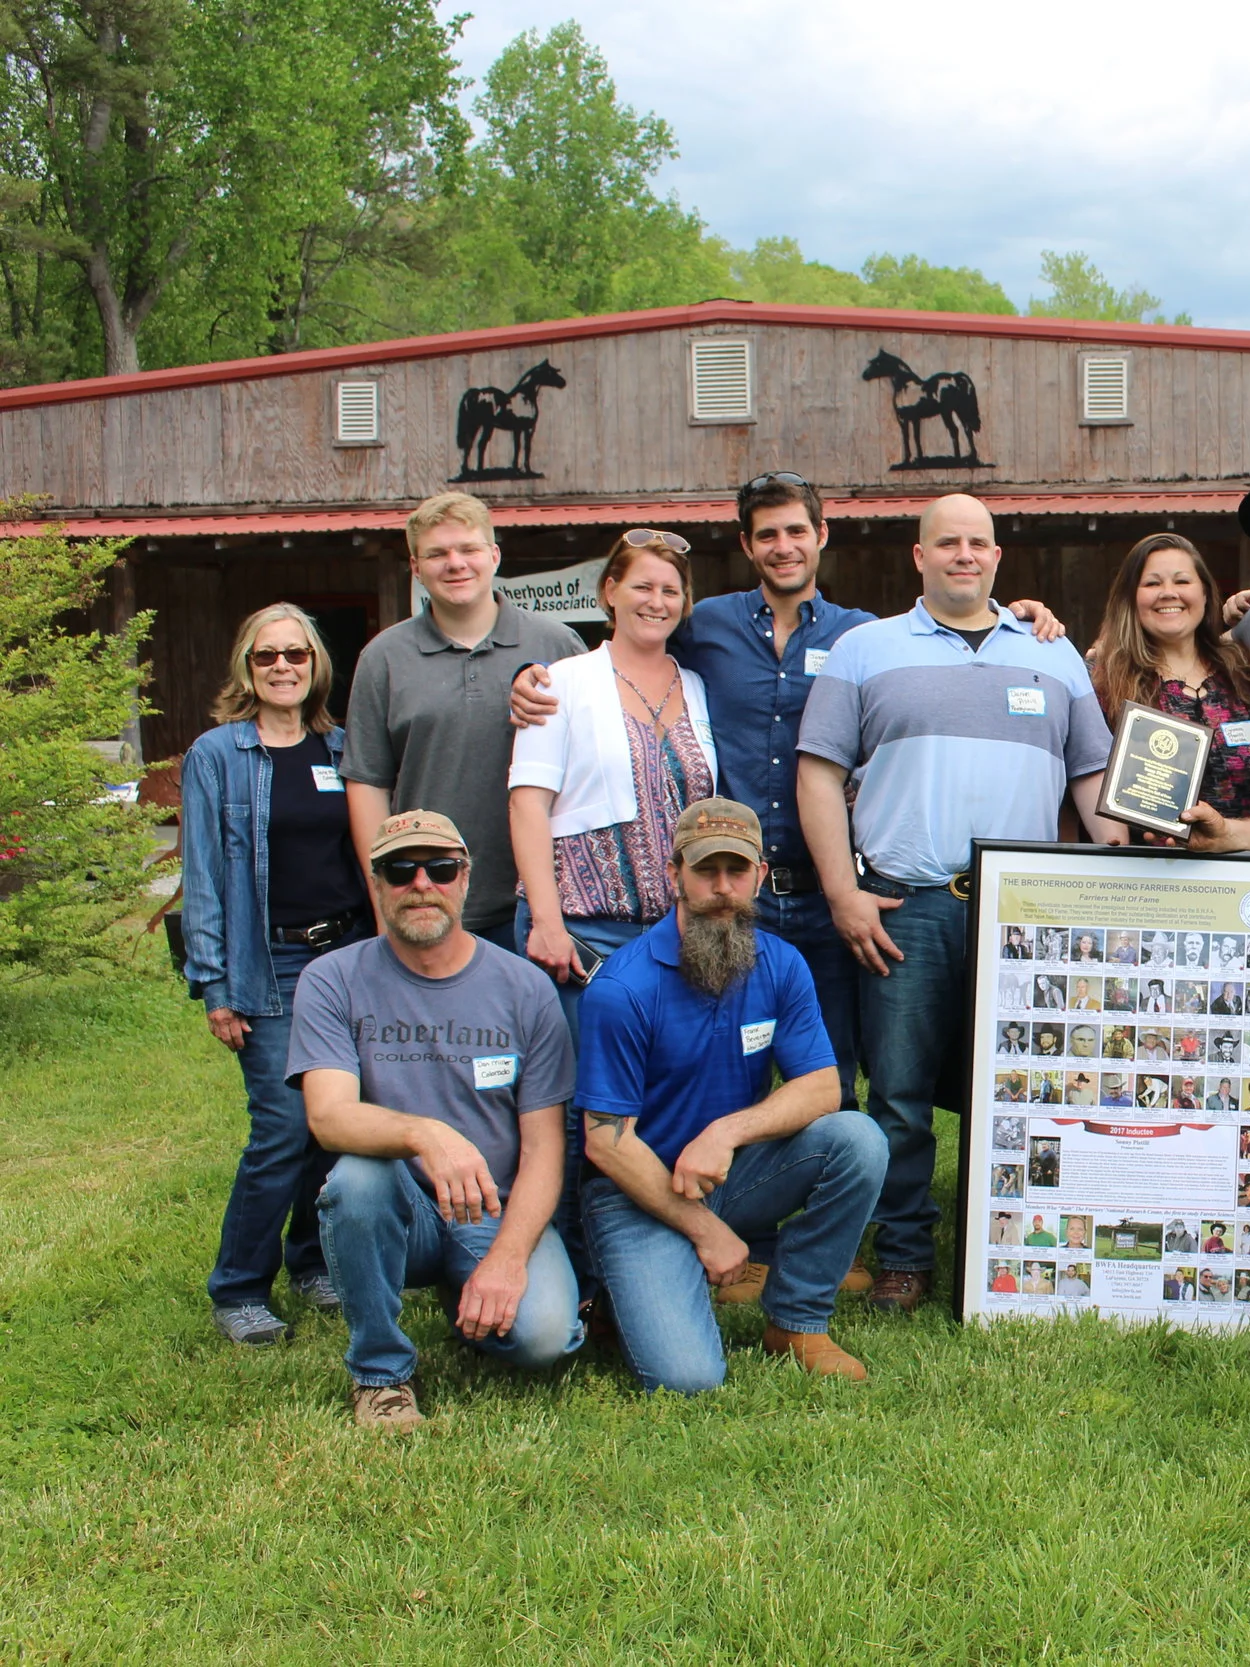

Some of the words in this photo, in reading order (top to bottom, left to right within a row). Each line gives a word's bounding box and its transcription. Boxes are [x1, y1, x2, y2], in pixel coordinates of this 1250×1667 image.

[502, 582, 562, 599] herhood
[567, 578, 580, 595] of
[533, 596, 597, 612] Associatio
[1004, 878, 1020, 886] THE
[1021, 879, 1084, 889] BROTHERHOOD
[1086, 881, 1097, 889] OF
[1100, 882, 1138, 891] WORKING
[1140, 884, 1180, 892] FARRIERS
[1182, 885, 1237, 894] ASSOCIATION
[1079, 894, 1109, 902] Farriers
[1139, 896, 1160, 904] Fame
[351, 1014, 511, 1049] Nederland
[374, 1053, 473, 1064] COLORADO
[1110, 1127, 1126, 1135] 2017
[1126, 1128, 1154, 1136] Inductee
[1096, 1261, 1116, 1269] BWFA
[1118, 1262, 1160, 1271] Headquarters
